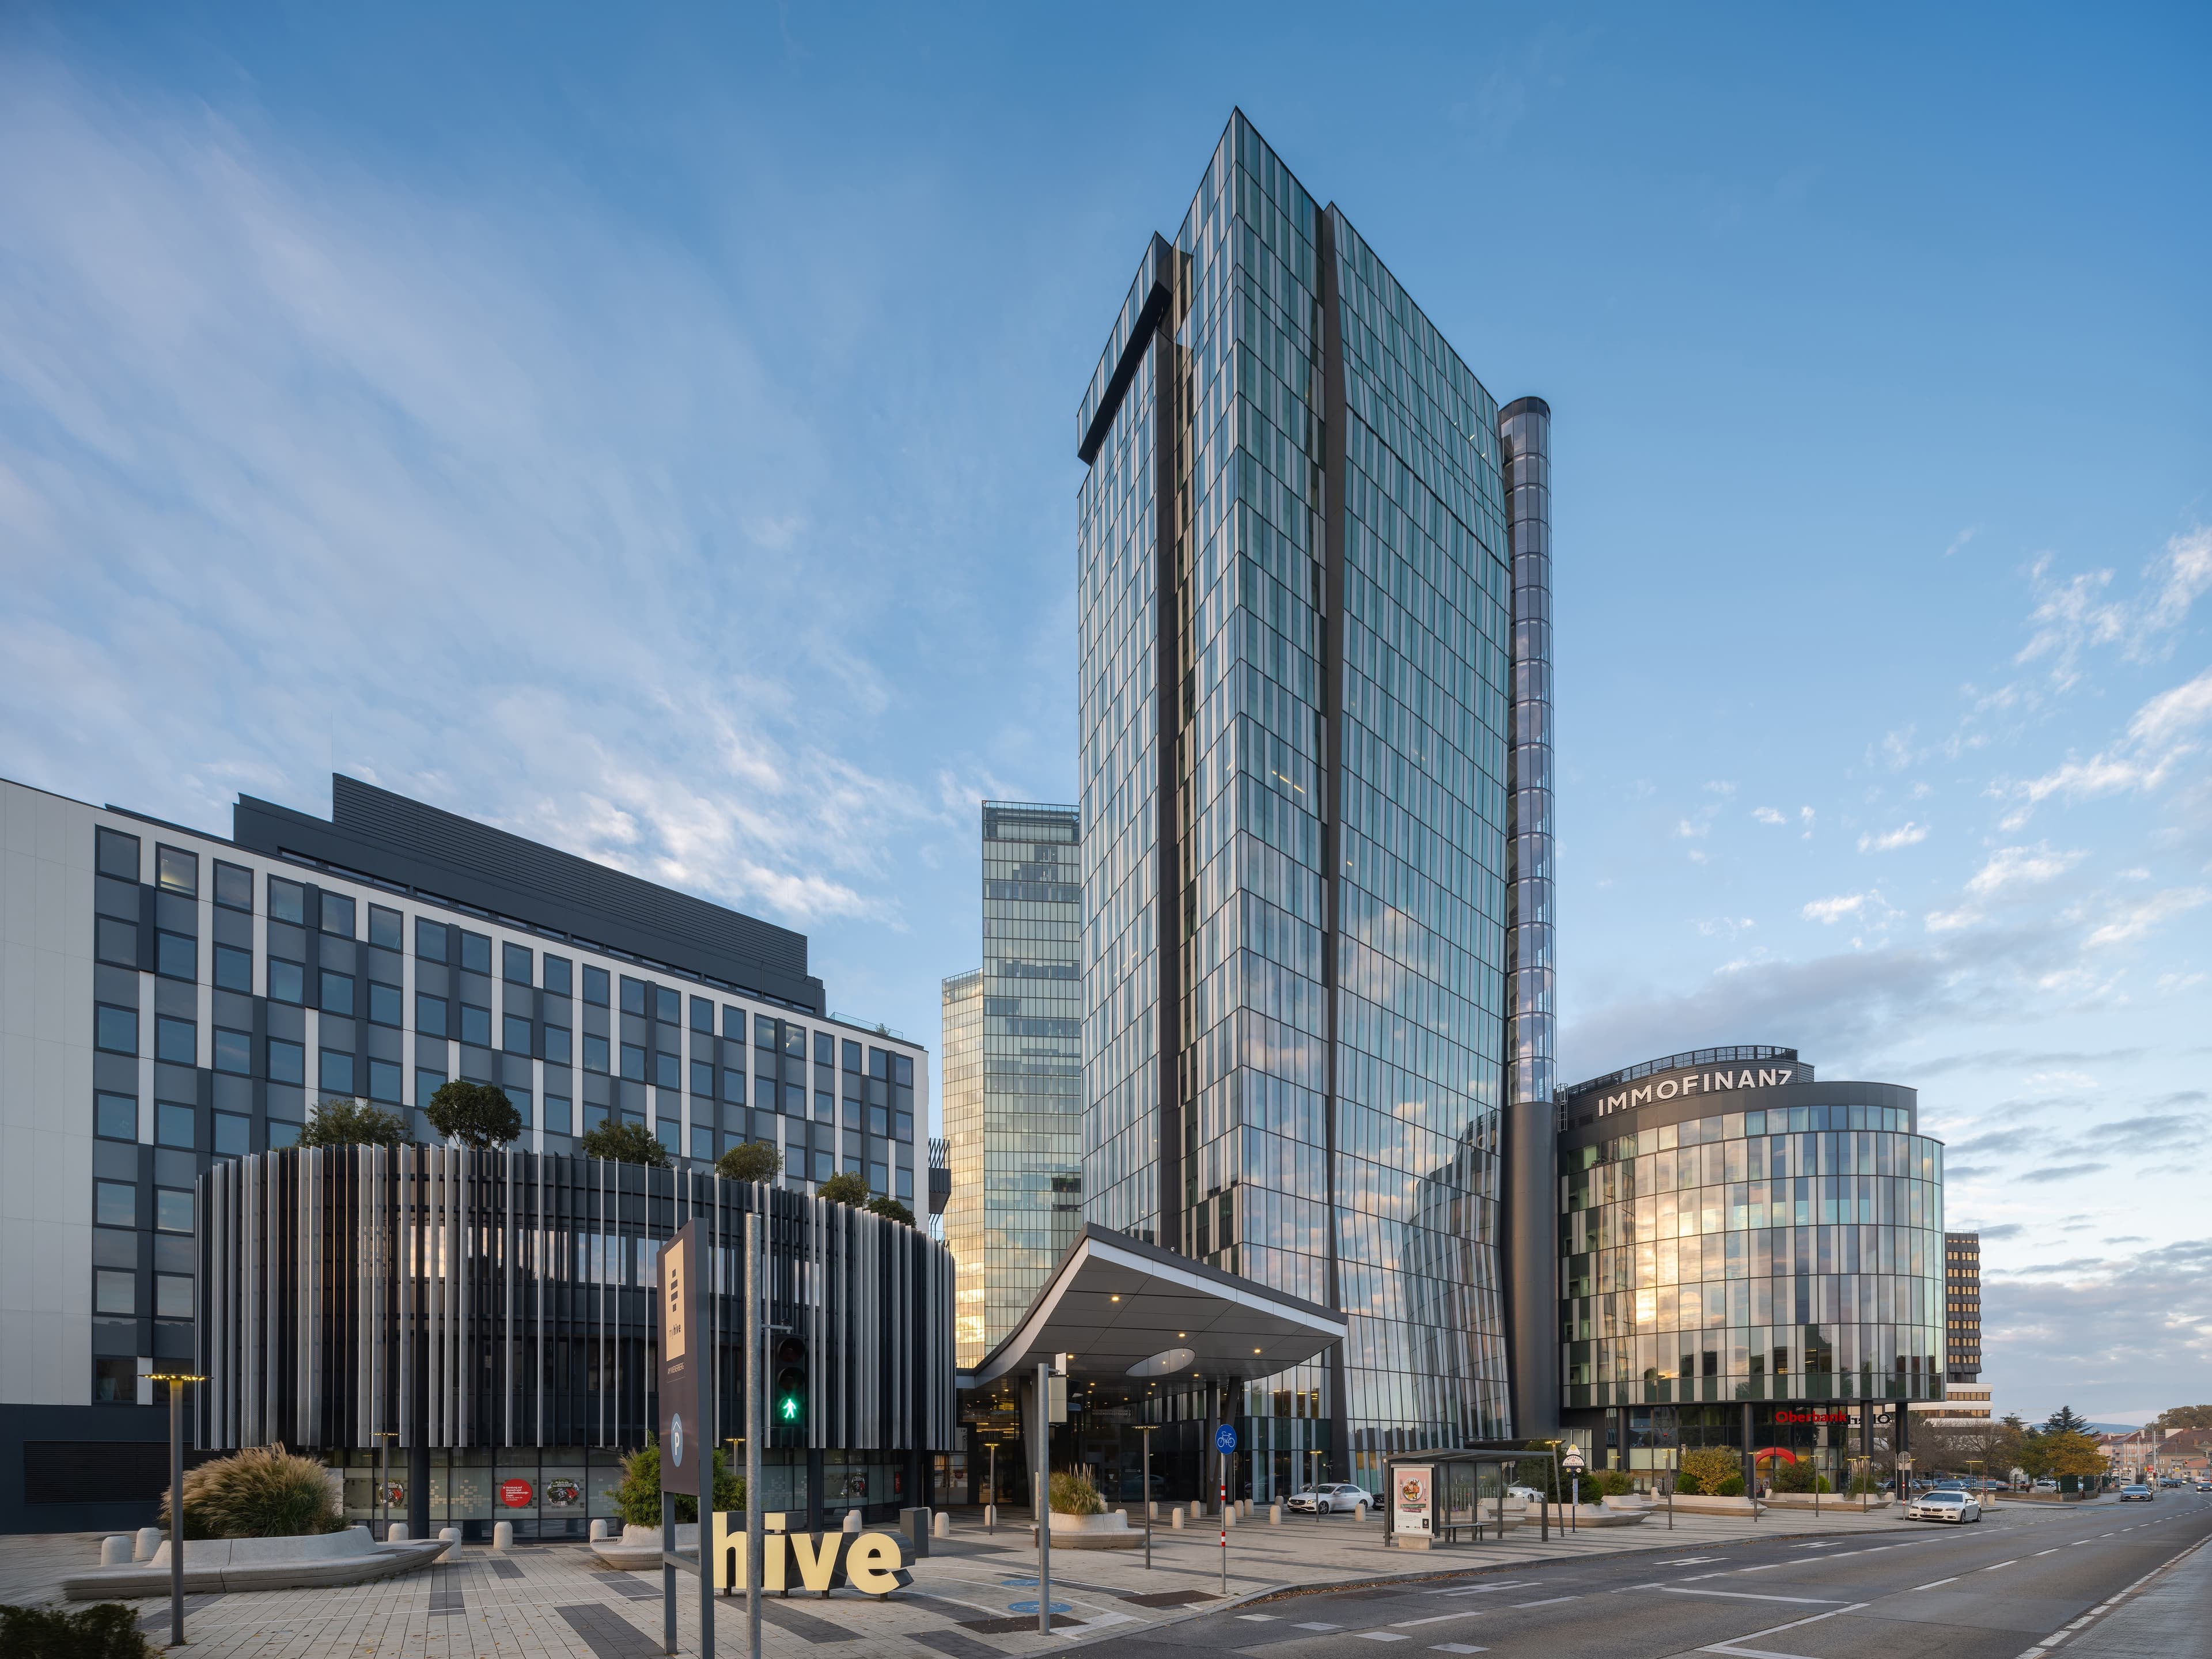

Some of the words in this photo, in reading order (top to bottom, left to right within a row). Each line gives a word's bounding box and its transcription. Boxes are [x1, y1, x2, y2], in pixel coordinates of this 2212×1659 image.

[1599, 1069, 1793, 1117] IMMOFINANZ
[669, 1324, 681, 1340] myhive
[1775, 1410, 1847, 1423] Oberbank
[713, 1512, 902, 1594] hive
